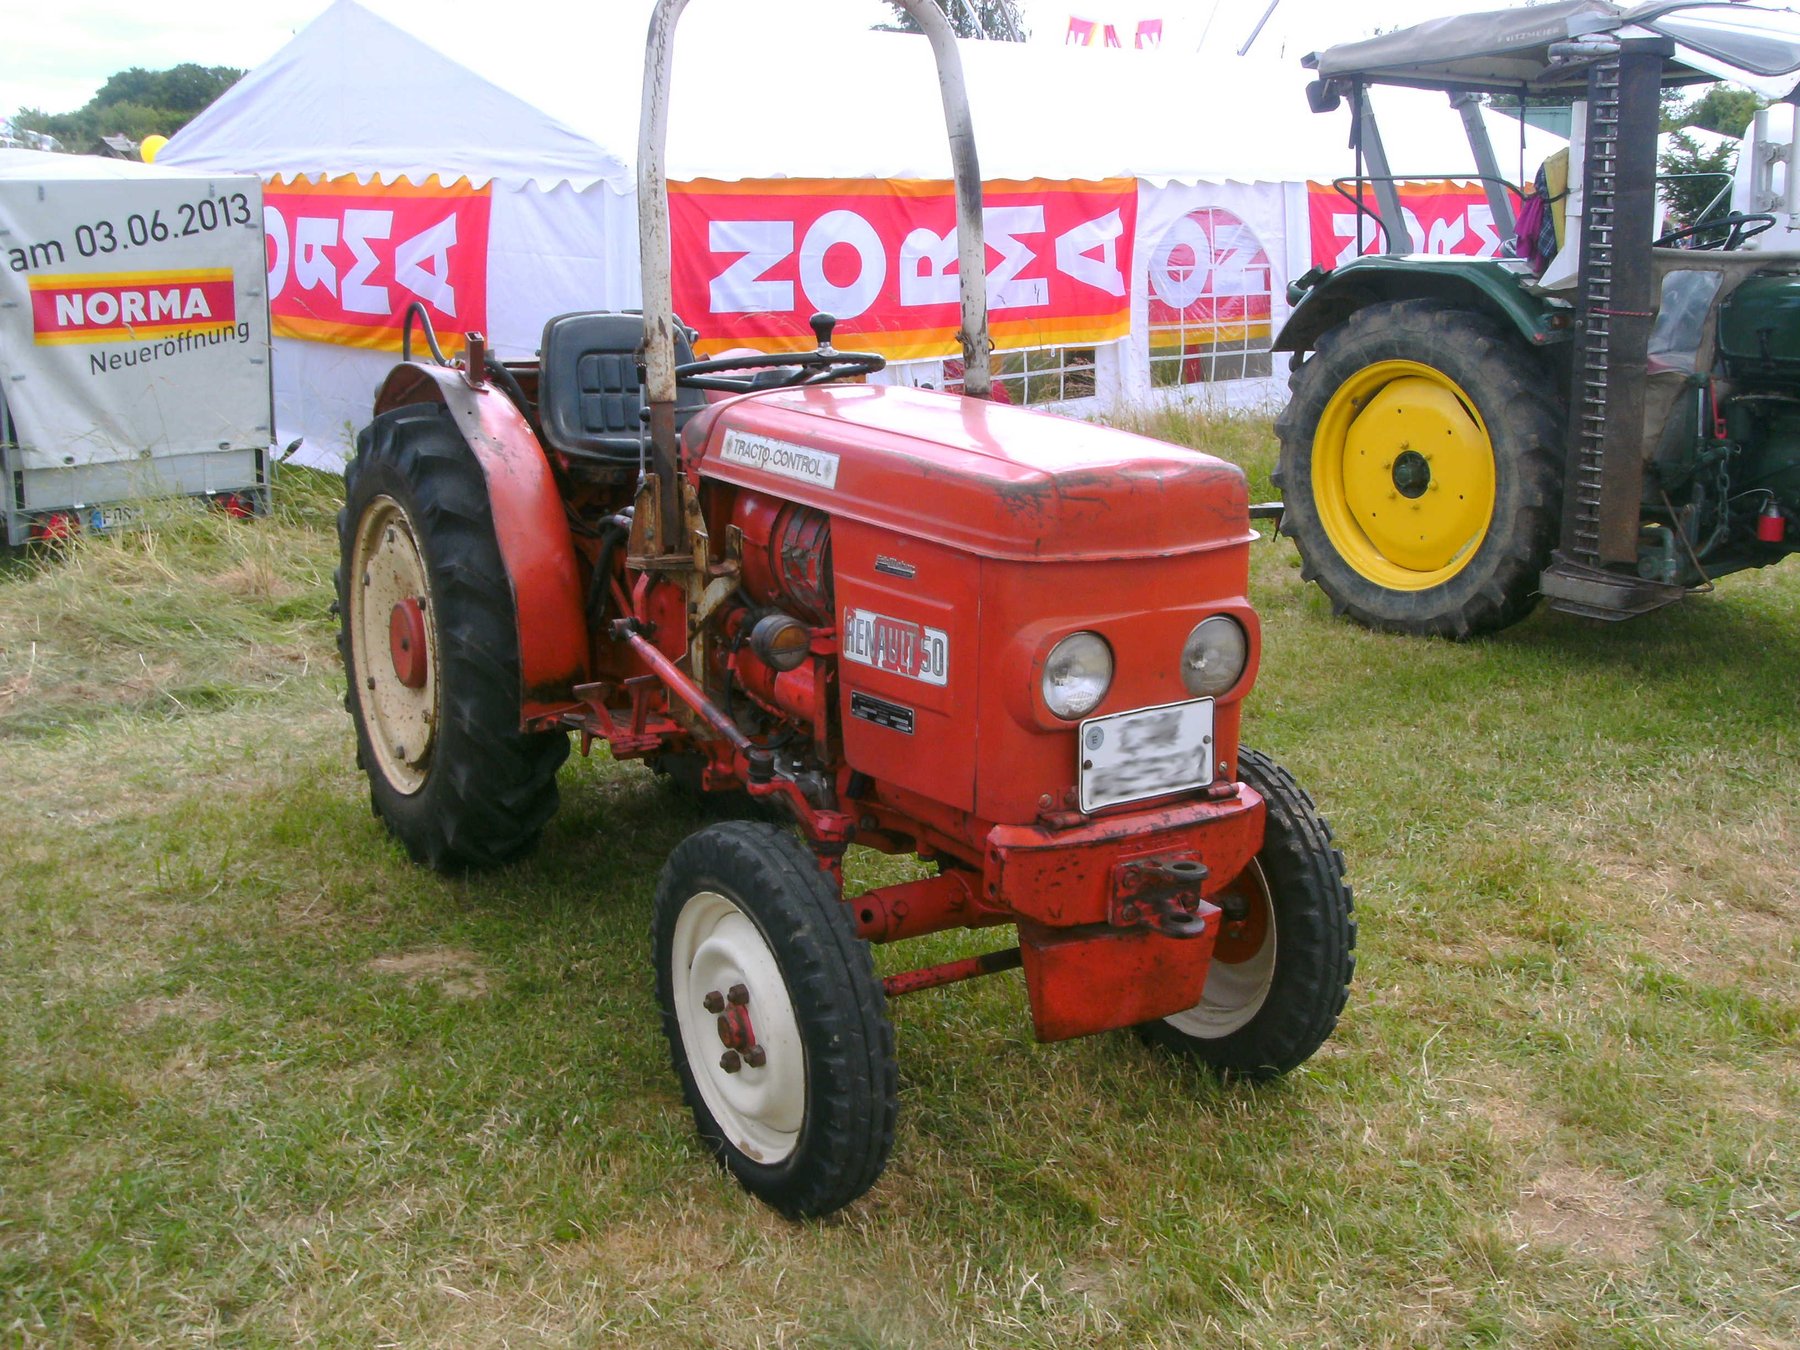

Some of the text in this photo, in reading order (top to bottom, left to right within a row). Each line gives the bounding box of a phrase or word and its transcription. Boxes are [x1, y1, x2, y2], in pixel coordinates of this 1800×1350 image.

[8, 193, 251, 272] am 03.06.2013
[708, 204, 1127, 320] NORMA
[56, 288, 212, 326] NORMA
[90, 322, 250, 375] Neueröffnung
[845, 616, 944, 677] RENAULT 50
